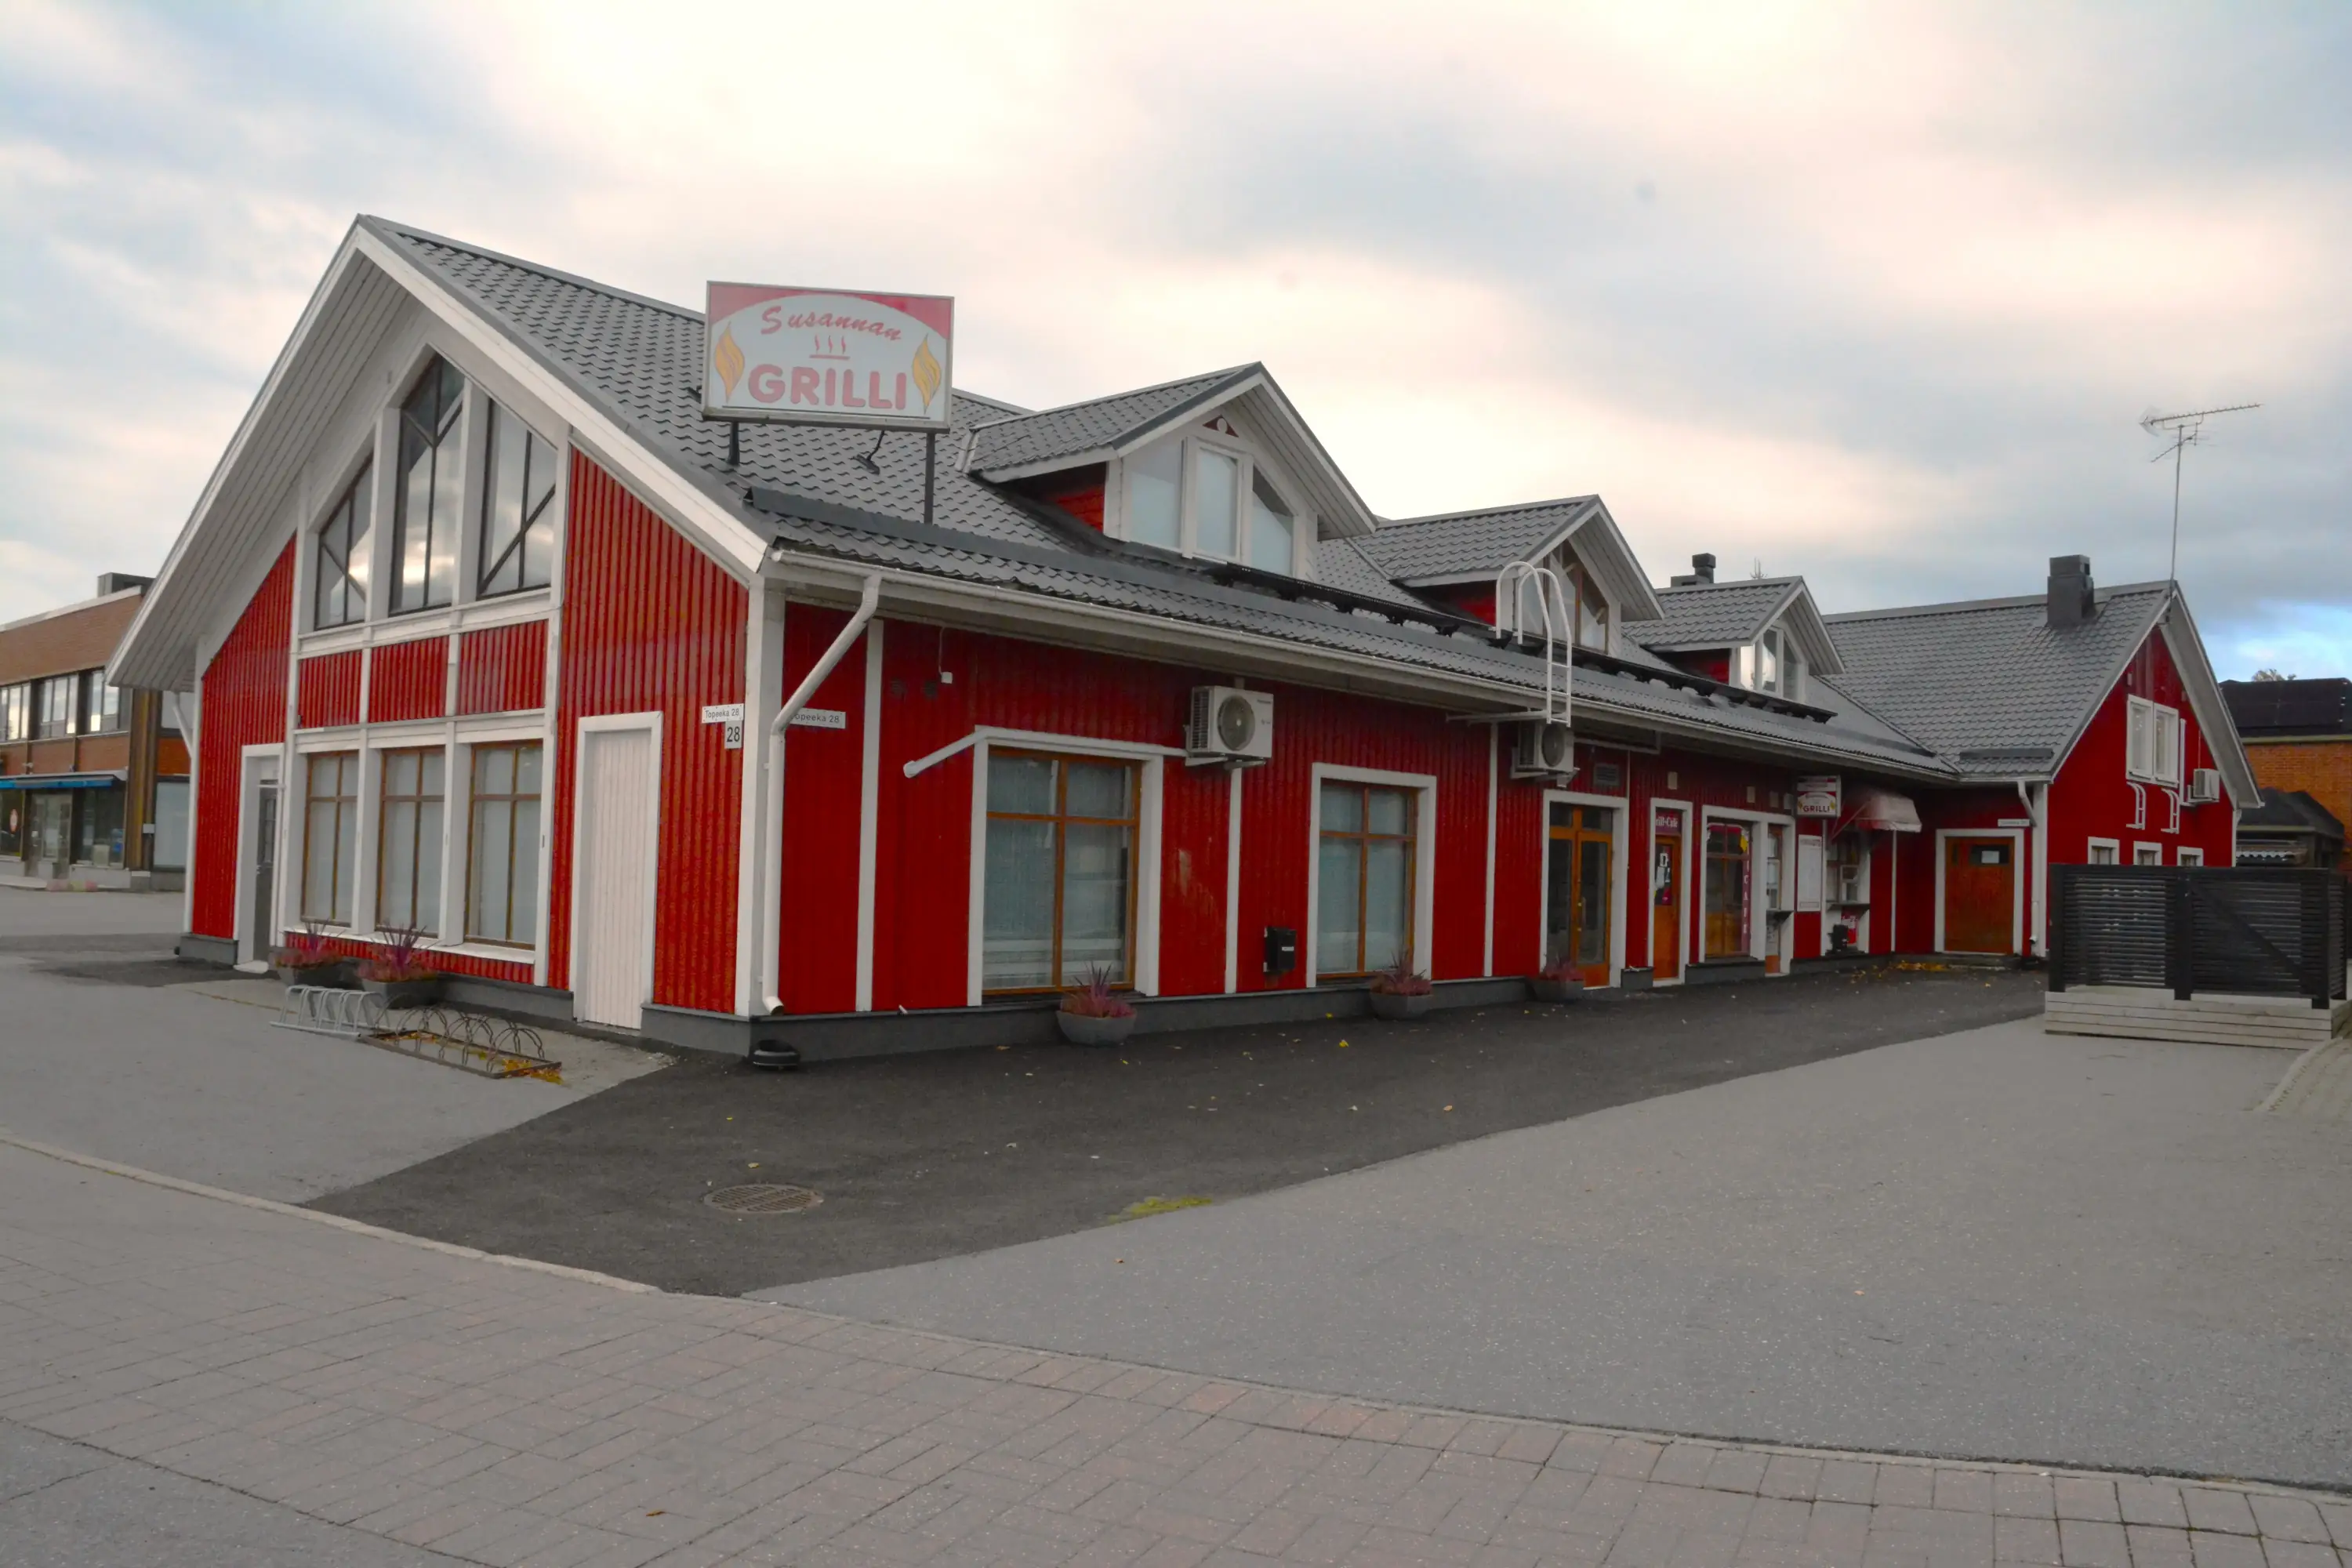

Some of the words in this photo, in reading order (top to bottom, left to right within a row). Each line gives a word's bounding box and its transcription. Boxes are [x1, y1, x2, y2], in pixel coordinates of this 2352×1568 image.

[760, 306, 902, 341] Susannan
[748, 363, 906, 410] GRILLI
[706, 709, 730, 720] Topeeka
[731, 708, 739, 717] 28
[793, 713, 826, 722] opeeka
[829, 714, 840, 724] 28
[727, 726, 740, 742] 28
